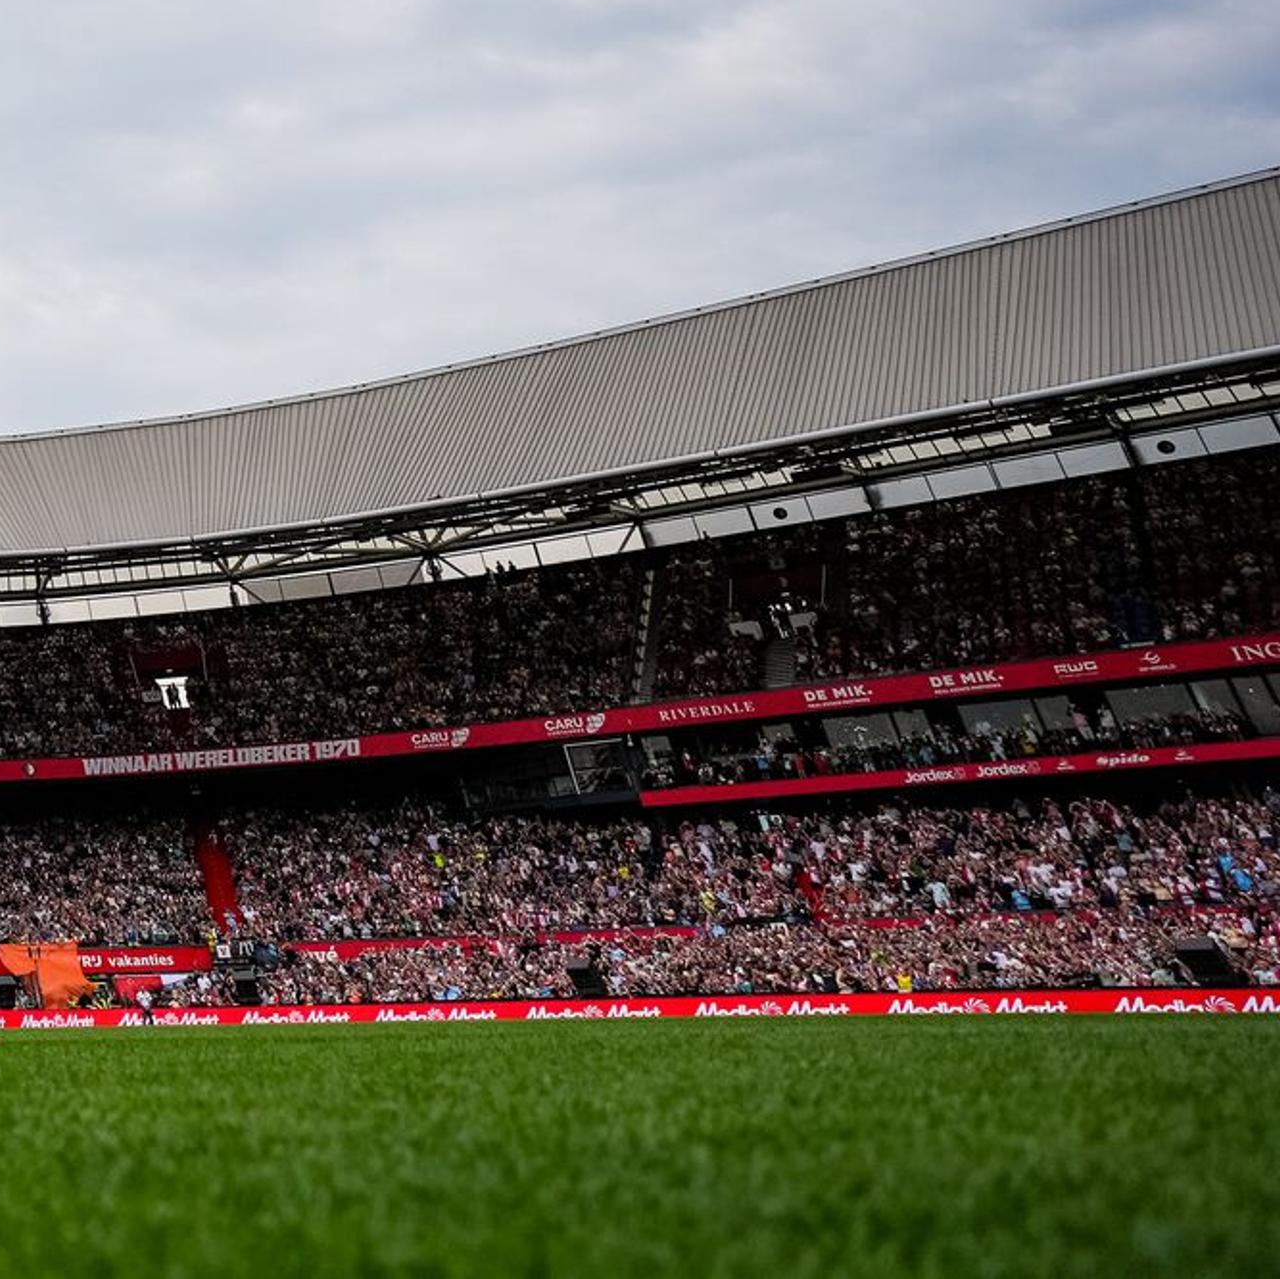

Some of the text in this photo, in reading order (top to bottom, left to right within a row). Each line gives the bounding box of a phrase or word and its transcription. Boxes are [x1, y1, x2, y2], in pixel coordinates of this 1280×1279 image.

[929, 674, 955, 688] DE
[804, 690, 827, 702] DE
[659, 701, 756, 722] RIVERDALE
[544, 716, 583, 731] CARU
[411, 731, 449, 745] CARU
[82, 739, 361, 776] WINNAAR WERELDBEKER 1970
[1096, 753, 1150, 767] Spido
[108, 953, 174, 967] vakanties
